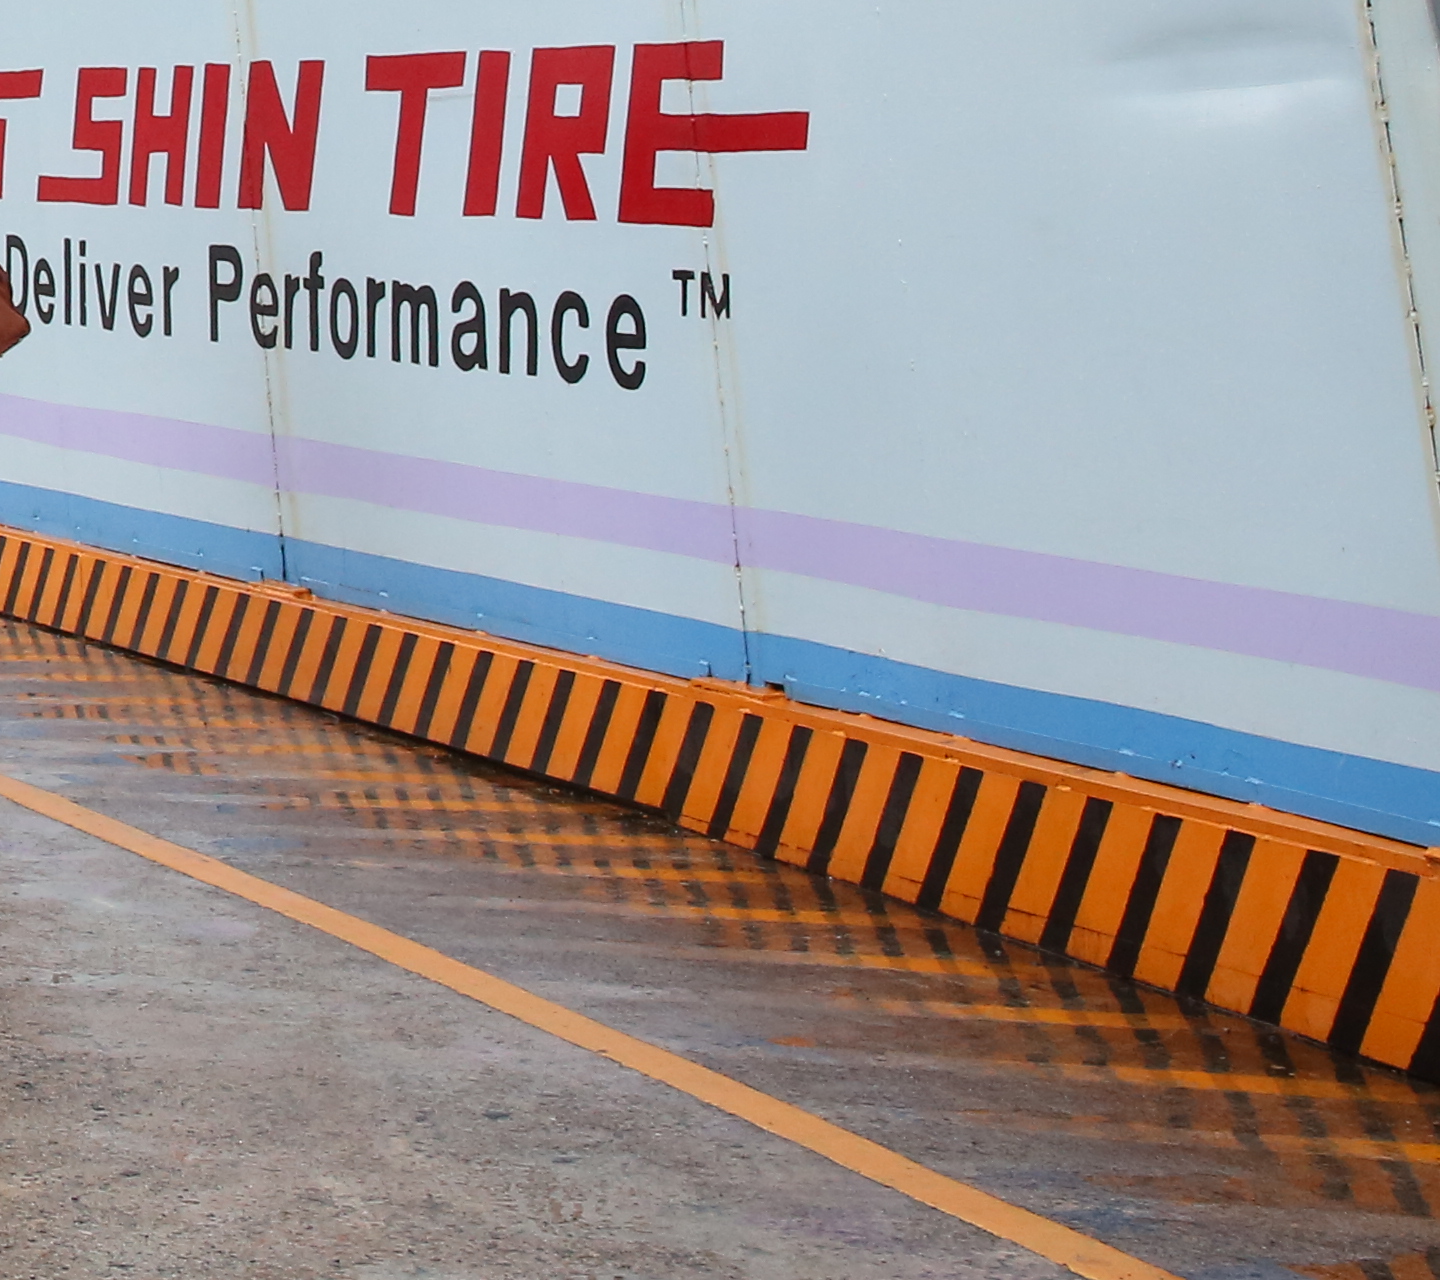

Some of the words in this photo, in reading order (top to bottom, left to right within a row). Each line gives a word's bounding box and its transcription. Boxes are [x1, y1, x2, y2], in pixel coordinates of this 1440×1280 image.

[37, 60, 325, 211] SHIN
[365, 40, 809, 227] TIRE
[6, 234, 179, 338] Deliver
[209, 245, 646, 390] Performance
